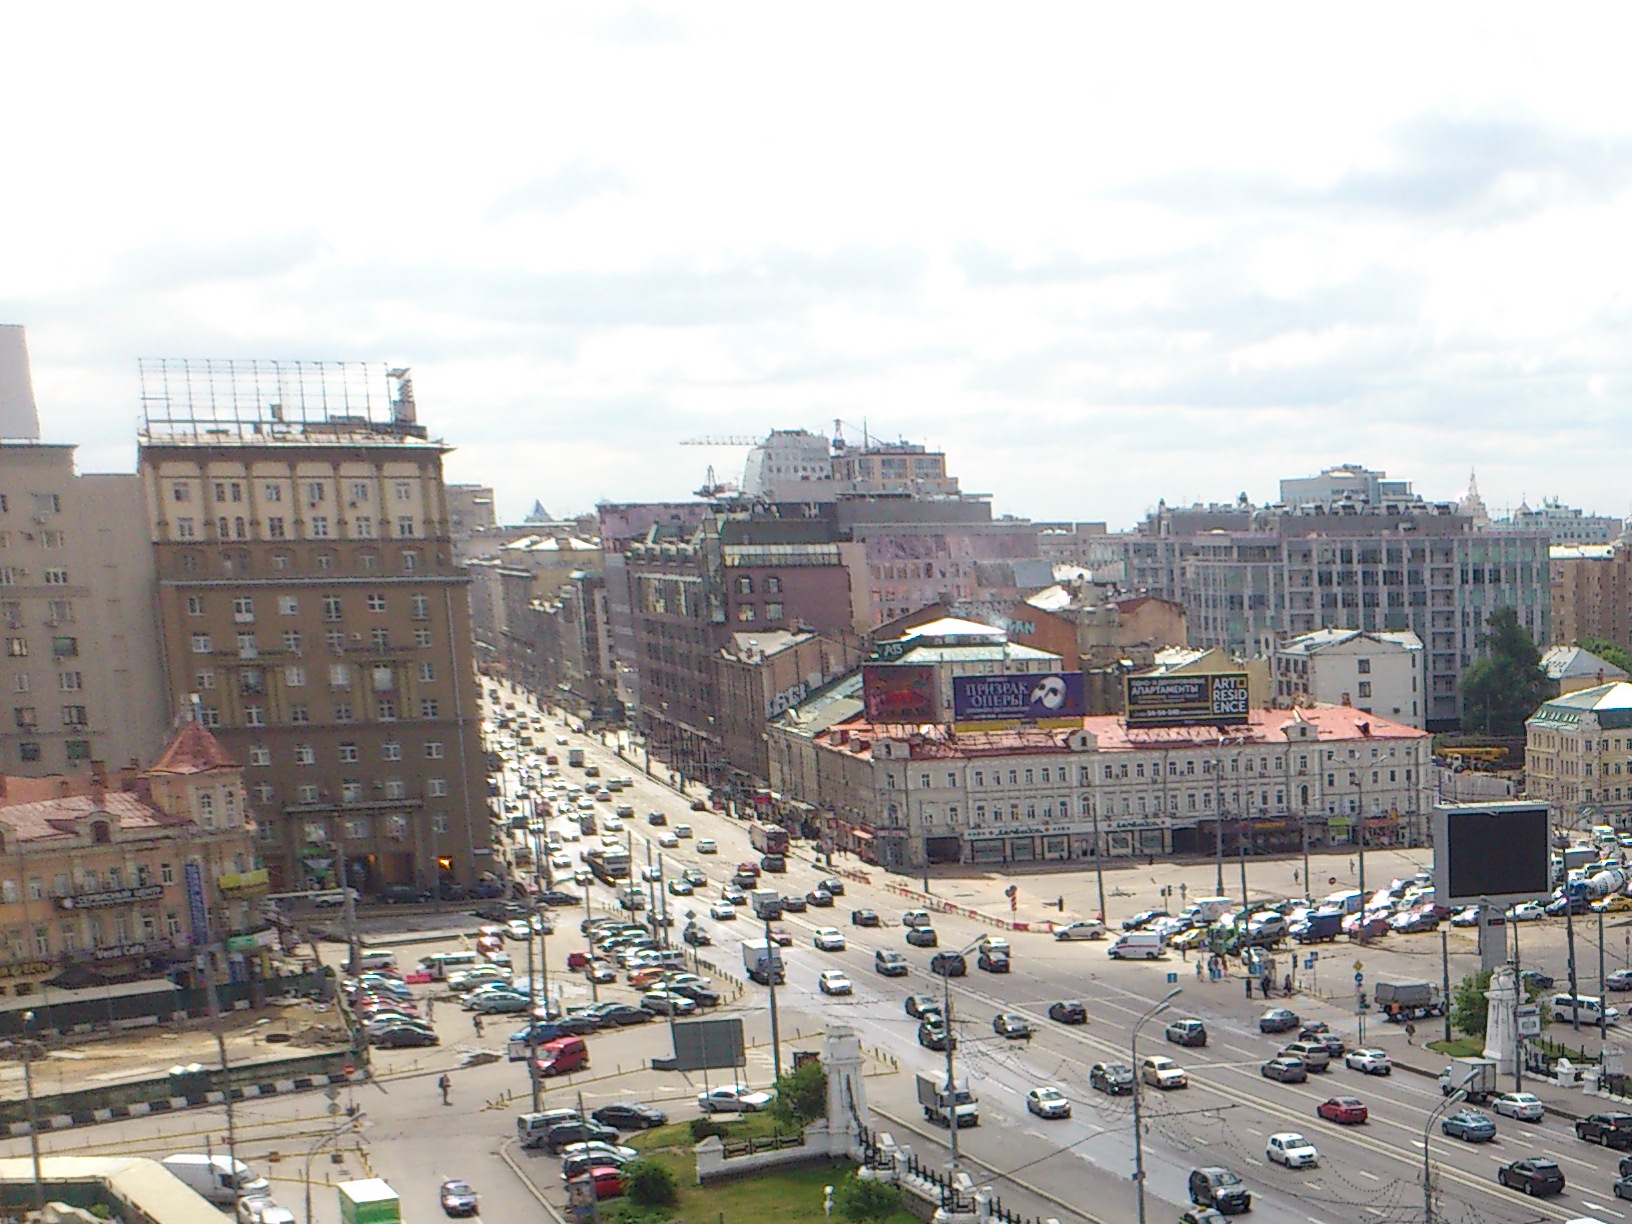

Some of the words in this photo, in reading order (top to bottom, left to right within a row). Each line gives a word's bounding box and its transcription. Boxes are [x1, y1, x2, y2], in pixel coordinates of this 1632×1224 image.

[965, 683, 1028, 696] ПРИЗРАК
[1213, 678, 1237, 689] ART
[1131, 684, 1199, 696] АПАРТАМЕНТЫ
[1213, 688, 1247, 701] RESID
[971, 695, 1024, 708] ОПЕРЫ
[1213, 701, 1247, 713] ENCE
